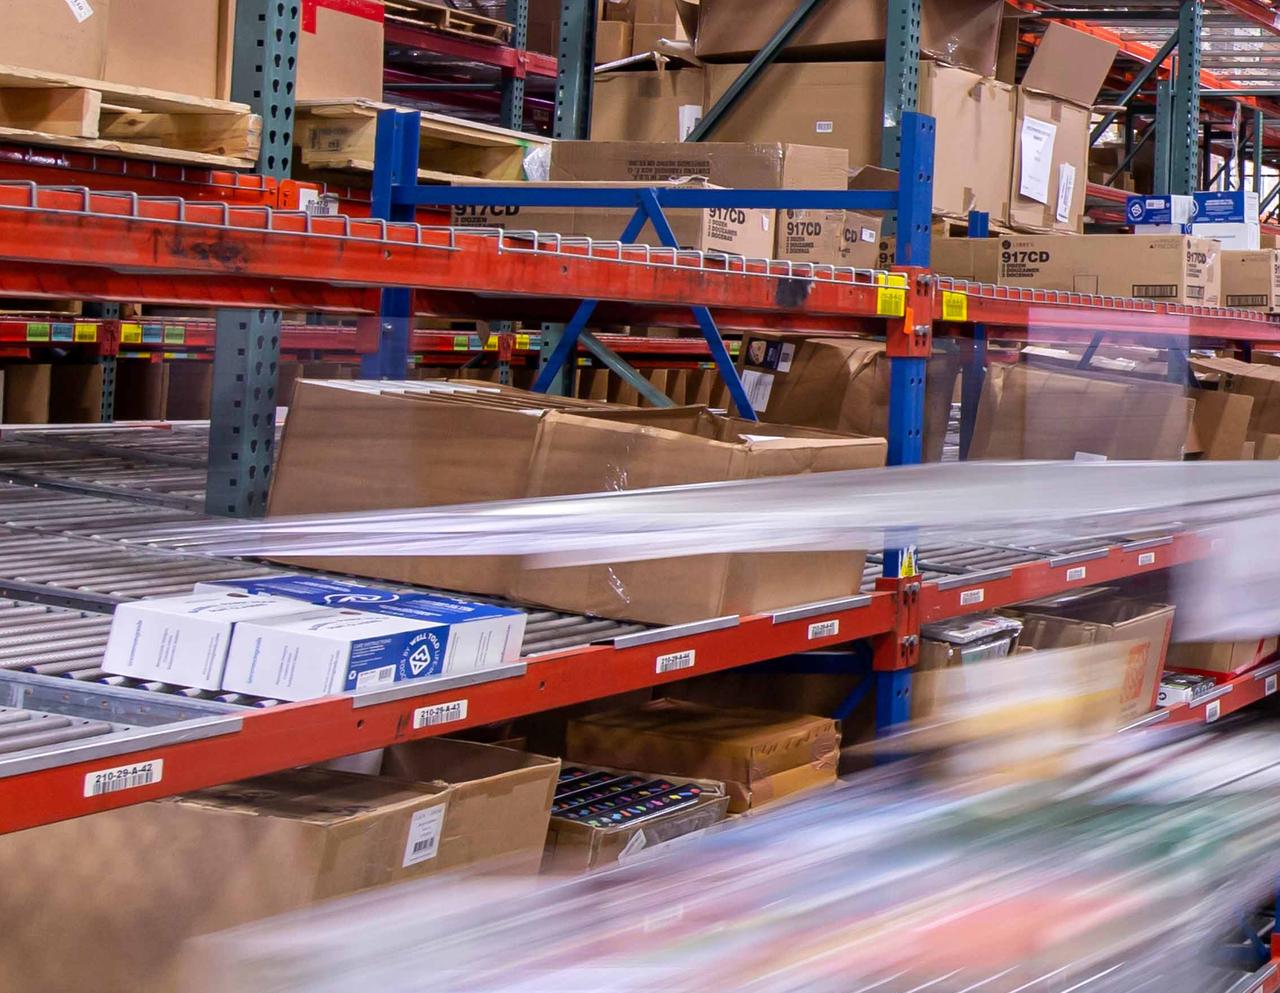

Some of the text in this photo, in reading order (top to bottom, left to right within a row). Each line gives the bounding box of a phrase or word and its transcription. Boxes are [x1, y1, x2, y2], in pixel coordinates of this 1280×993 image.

[708, 207, 746, 225] 917CD
[786, 221, 822, 237] 917CD
[1001, 251, 1050, 263] 917CD
[409, 632, 427, 646] WELL
[428, 632, 440, 650] TOLD
[95, 763, 153, 784] 210-29-A-42
